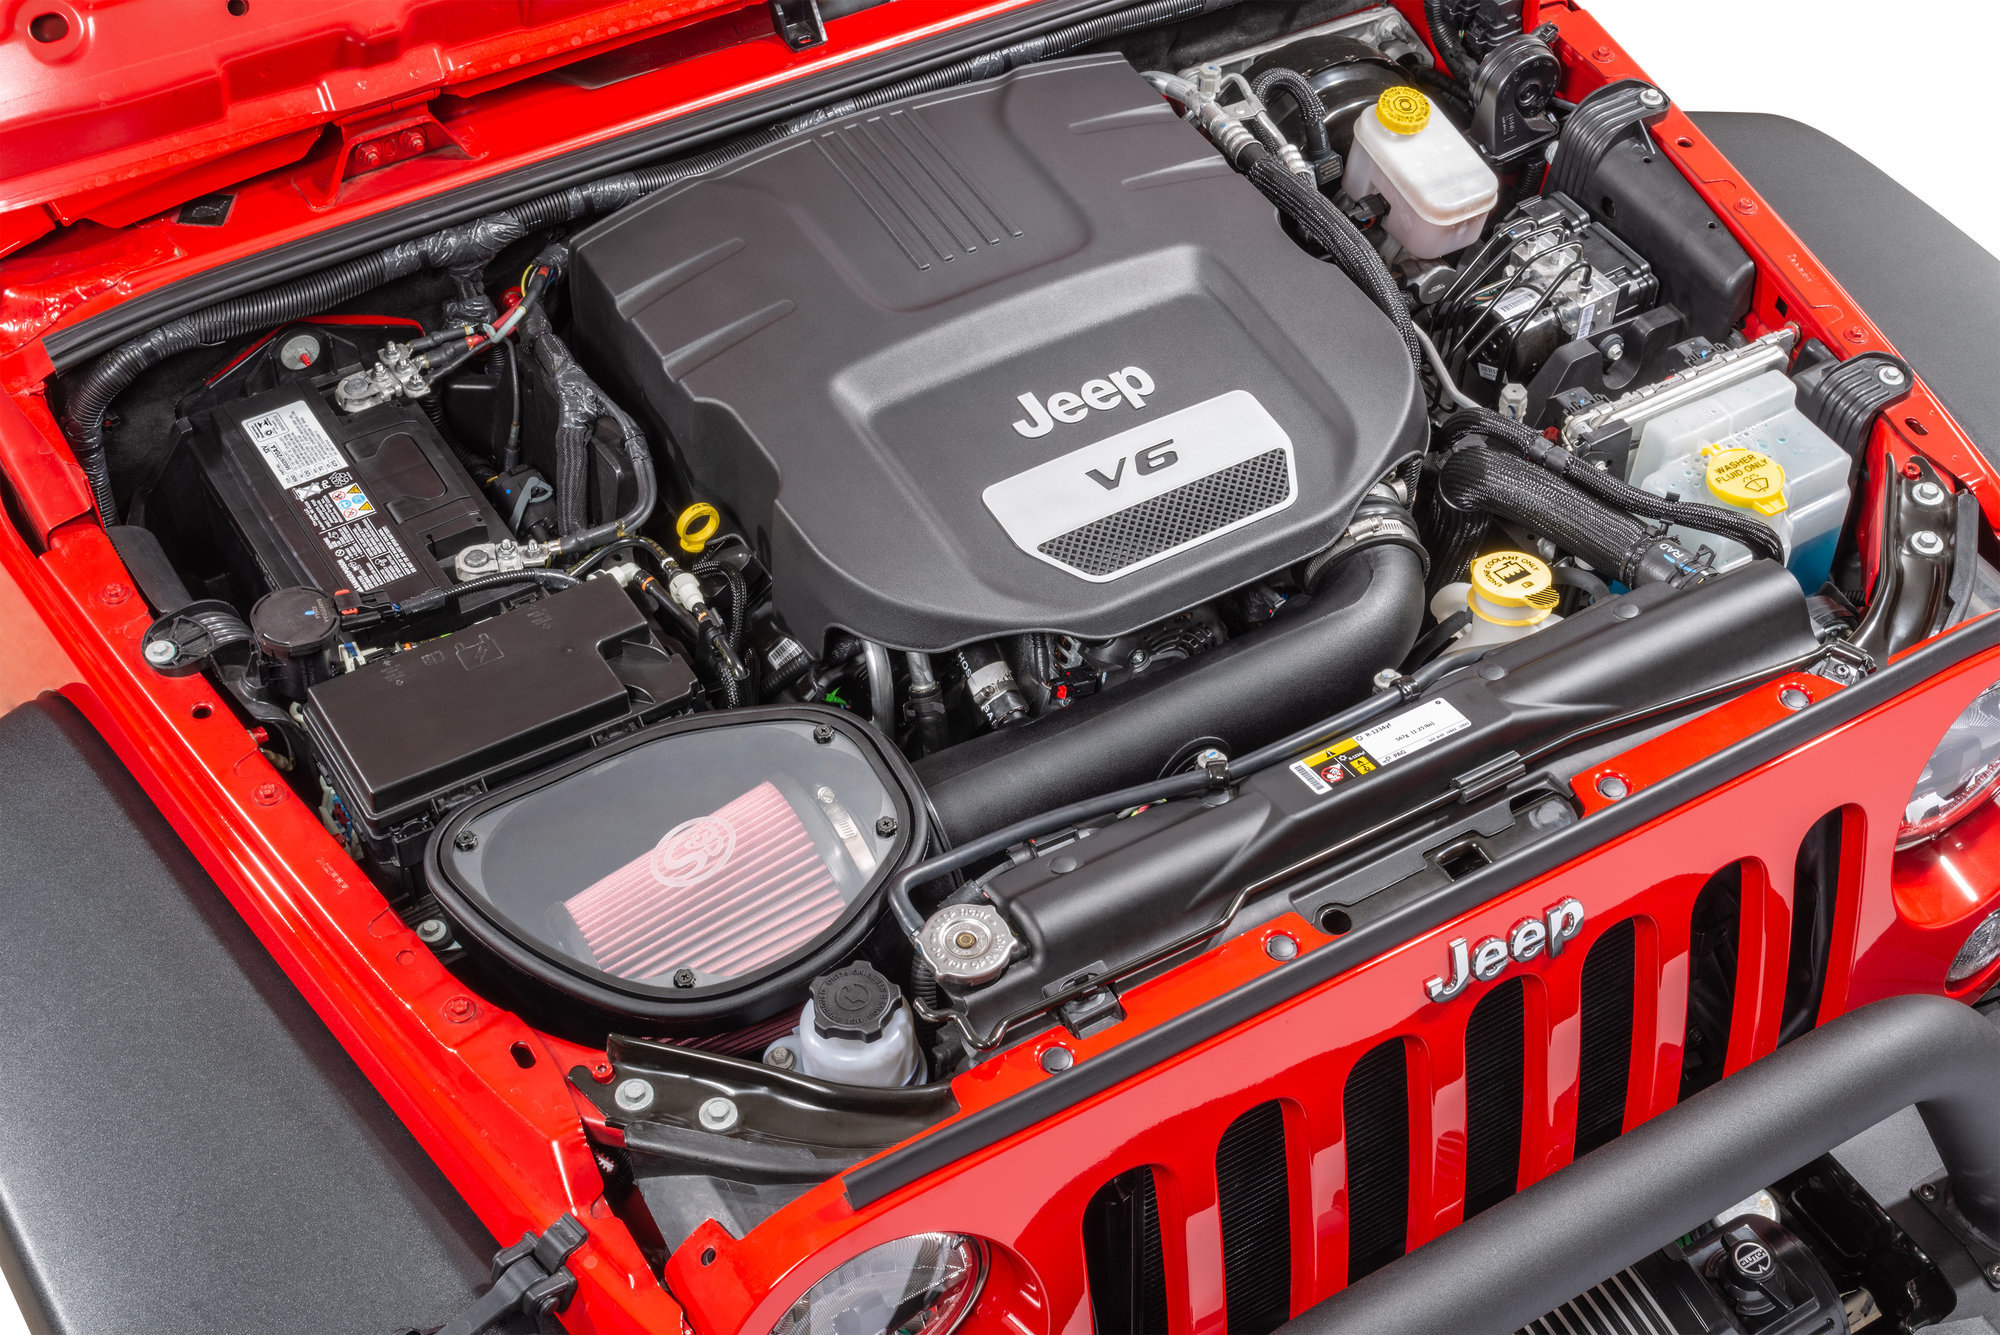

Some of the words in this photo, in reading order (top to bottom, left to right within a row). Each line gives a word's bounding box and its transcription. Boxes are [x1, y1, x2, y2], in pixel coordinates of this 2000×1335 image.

[1012, 366, 1155, 438] Jeep
[260, 444, 270, 453] 12V
[1085, 438, 1178, 491] V6
[1714, 454, 1756, 474] WASHER
[1715, 470, 1743, 484] FLUID
[1744, 459, 1768, 473] ONLY
[1660, 543, 1684, 558] RAD
[1485, 555, 1519, 568] COOLANT
[1521, 558, 1540, 571] ONLY
[1483, 569, 1502, 588] ENGINE
[1365, 723, 1392, 737] R-1234yf
[1393, 749, 1407, 758] PAG
[1425, 897, 1584, 1004] Jeep
[1740, 1249, 1767, 1267] CLUTCH
